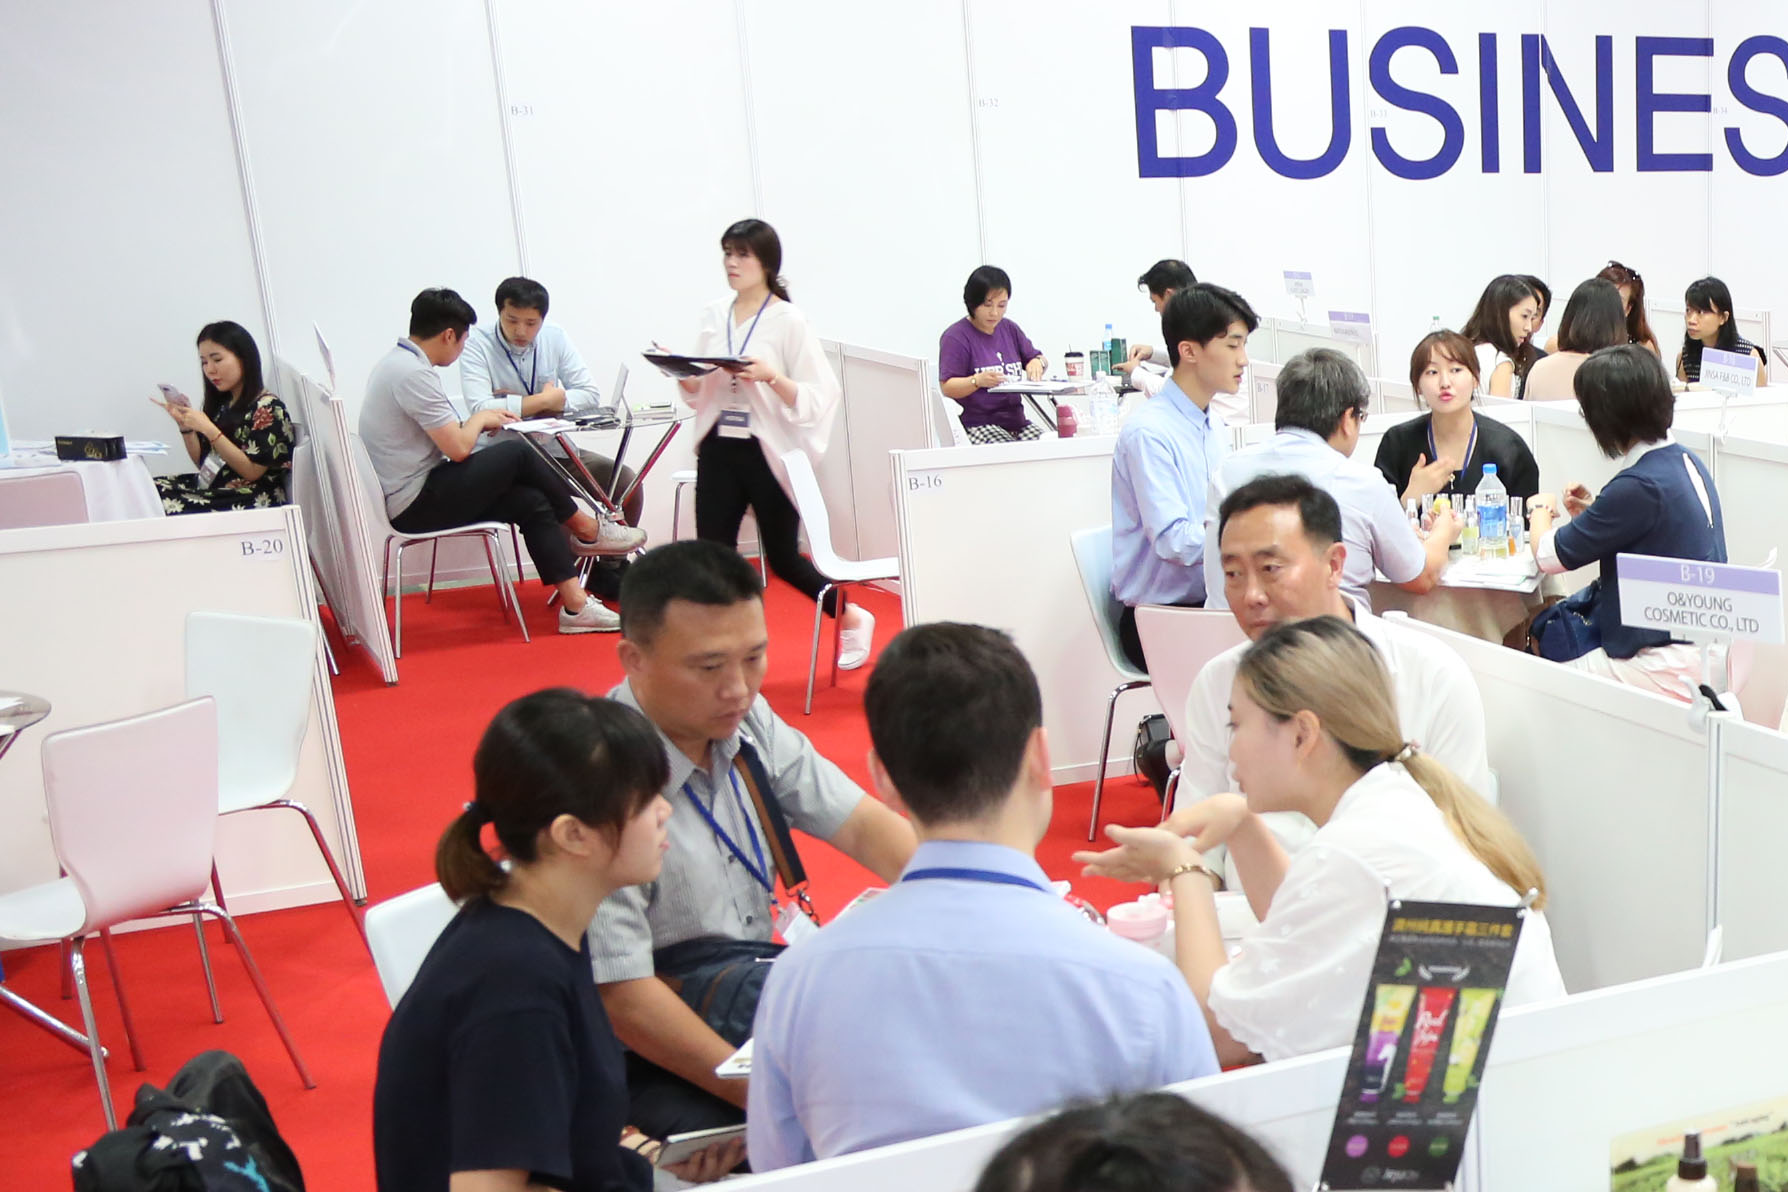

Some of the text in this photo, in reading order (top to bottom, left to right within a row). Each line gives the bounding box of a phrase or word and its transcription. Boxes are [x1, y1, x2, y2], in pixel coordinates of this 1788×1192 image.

[908, 475, 943, 491] B-16
[241, 539, 284, 556] B-20
[1680, 564, 1715, 585] B-19
[1667, 591, 1733, 613] O&YOUNG
[1644, 606, 1760, 633] COSMETIC CO., LTD
